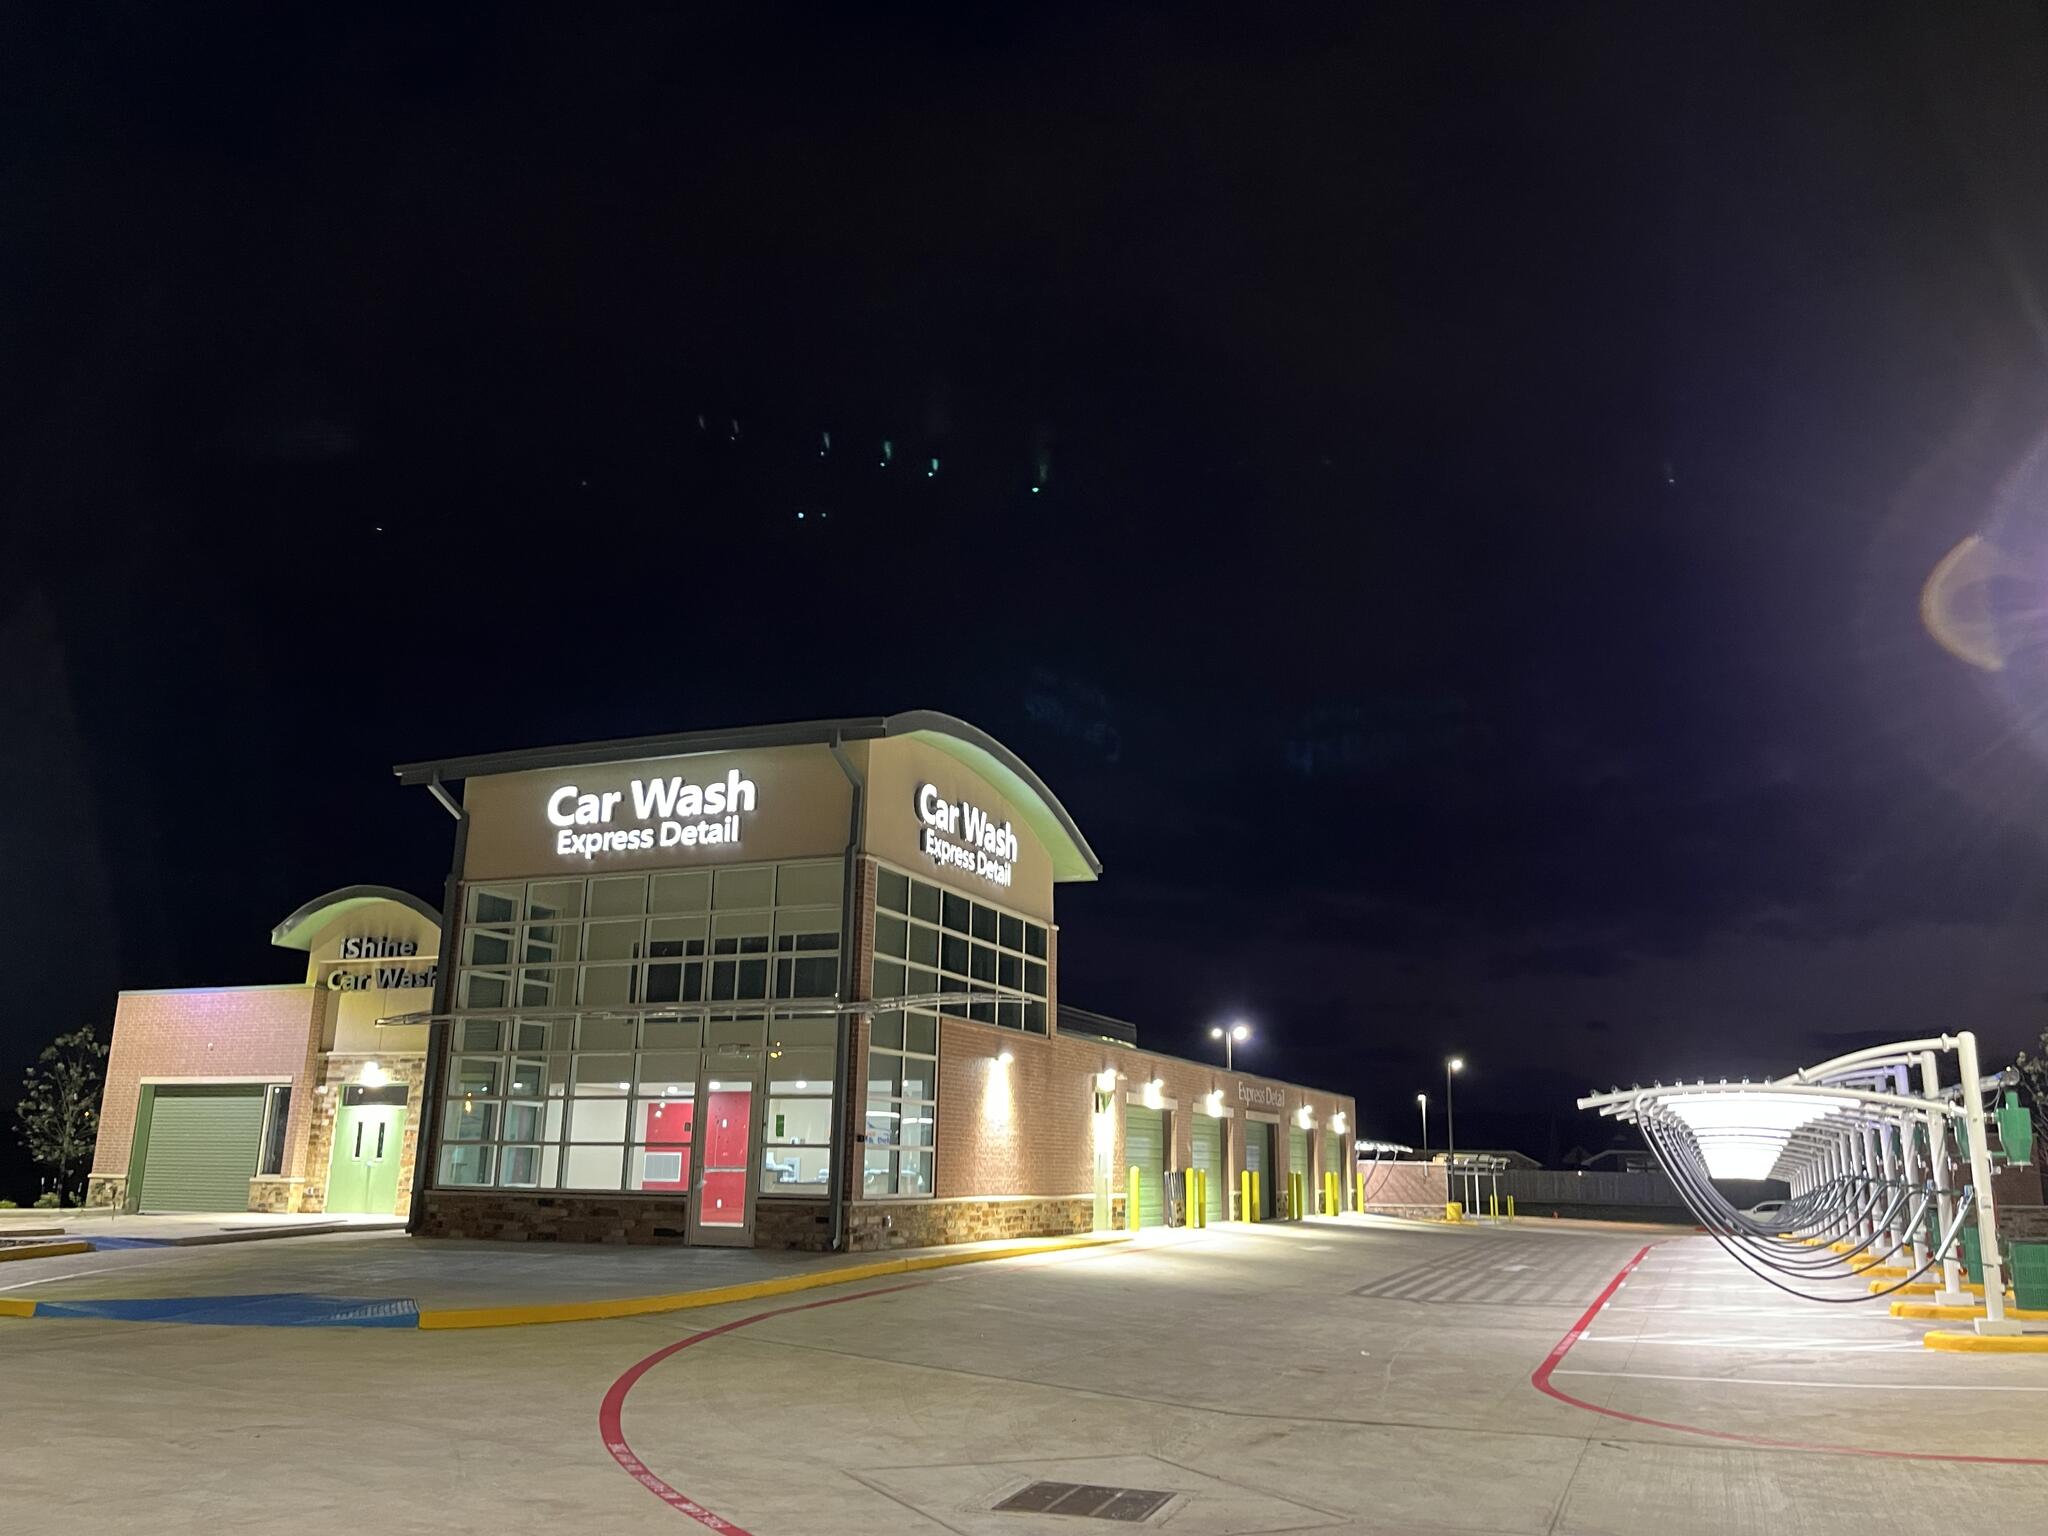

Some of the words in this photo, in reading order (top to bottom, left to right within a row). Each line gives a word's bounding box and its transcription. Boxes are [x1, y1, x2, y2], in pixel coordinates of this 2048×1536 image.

[547, 785, 623, 827] Car
[630, 768, 757, 820] Wash
[556, 828, 656, 860] Express
[659, 815, 741, 847] Detail
[918, 783, 960, 834] Car
[962, 801, 1018, 863] Wash
[924, 827, 976, 872] Express
[976, 850, 1012, 887] Detail
[339, 936, 418, 960] iShine
[327, 969, 371, 993] Car
[1238, 1080, 1266, 1108] Express
[1265, 1086, 1285, 1108] Detail
